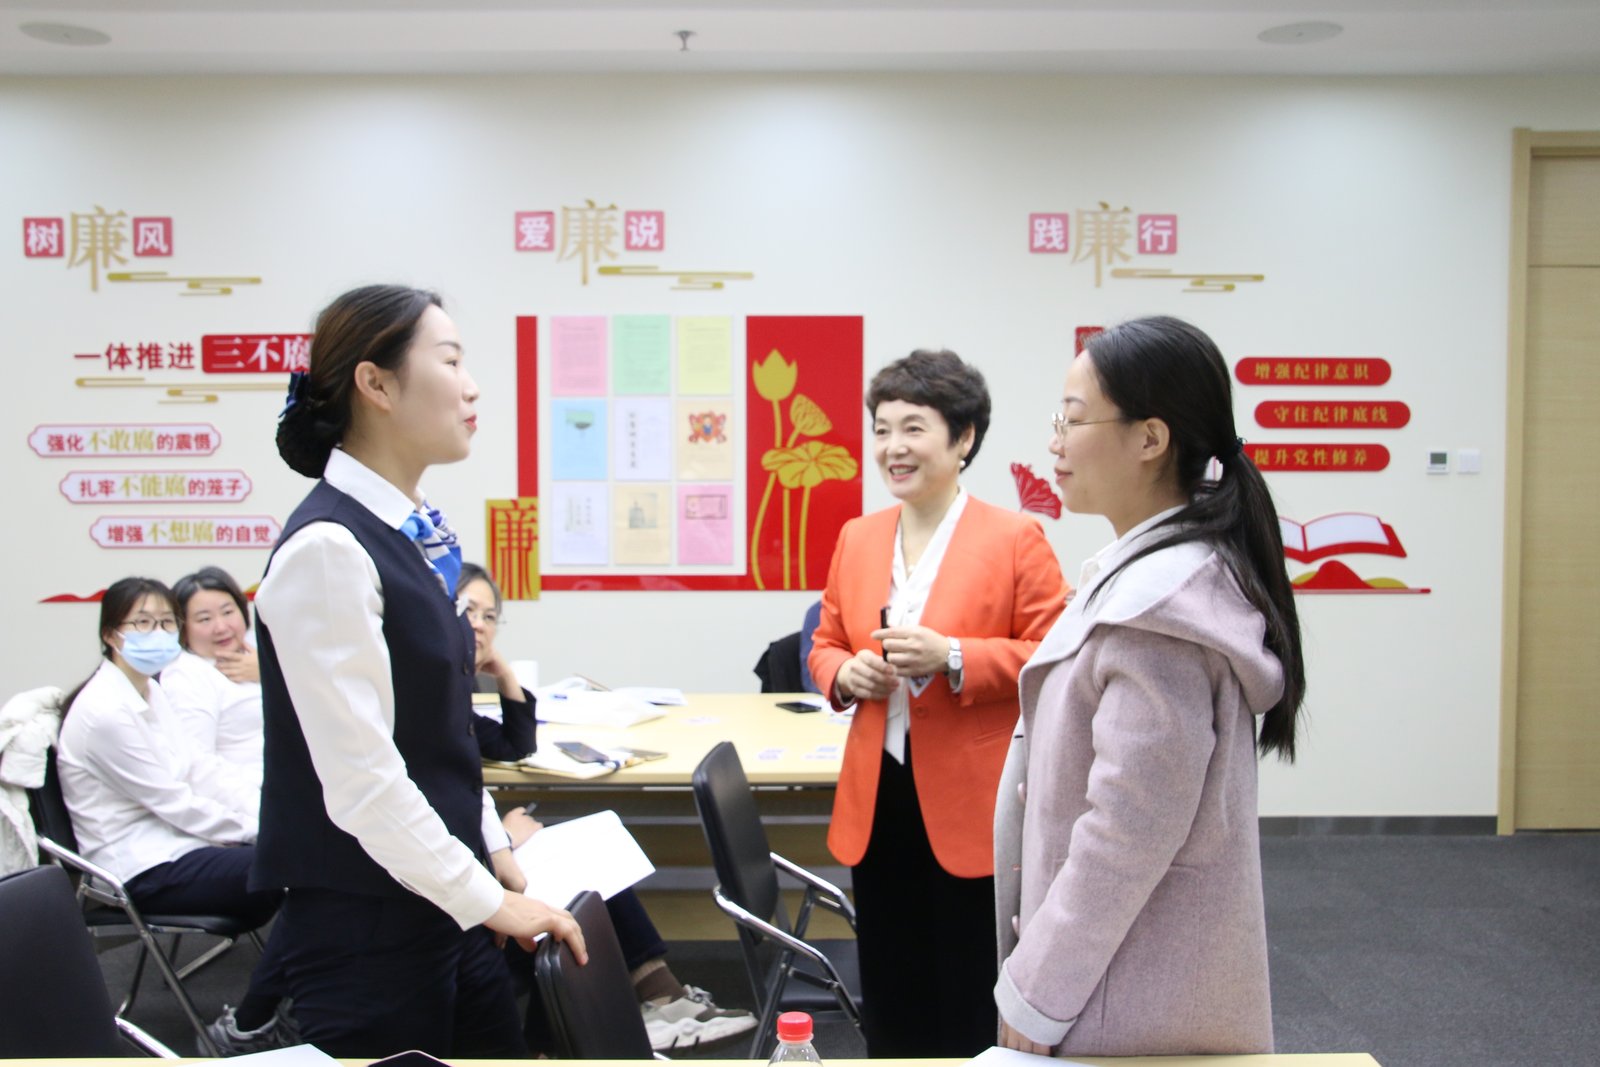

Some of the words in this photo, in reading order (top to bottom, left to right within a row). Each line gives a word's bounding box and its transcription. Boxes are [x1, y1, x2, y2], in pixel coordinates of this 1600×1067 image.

[27, 204, 168, 292] 树廉风
[518, 199, 661, 285] 爱廉说
[1032, 201, 1172, 288] 践廉行
[1254, 362, 1368, 380] 增强纪律意识
[1273, 405, 1388, 423] 守住纪律底线
[47, 429, 212, 452] 强化不敢腐的震慑
[1254, 447, 1367, 466] 提升党性修养
[79, 474, 242, 497] 扎牢不能腐的笼子
[107, 519, 271, 544] 增强不想腐的自觉
